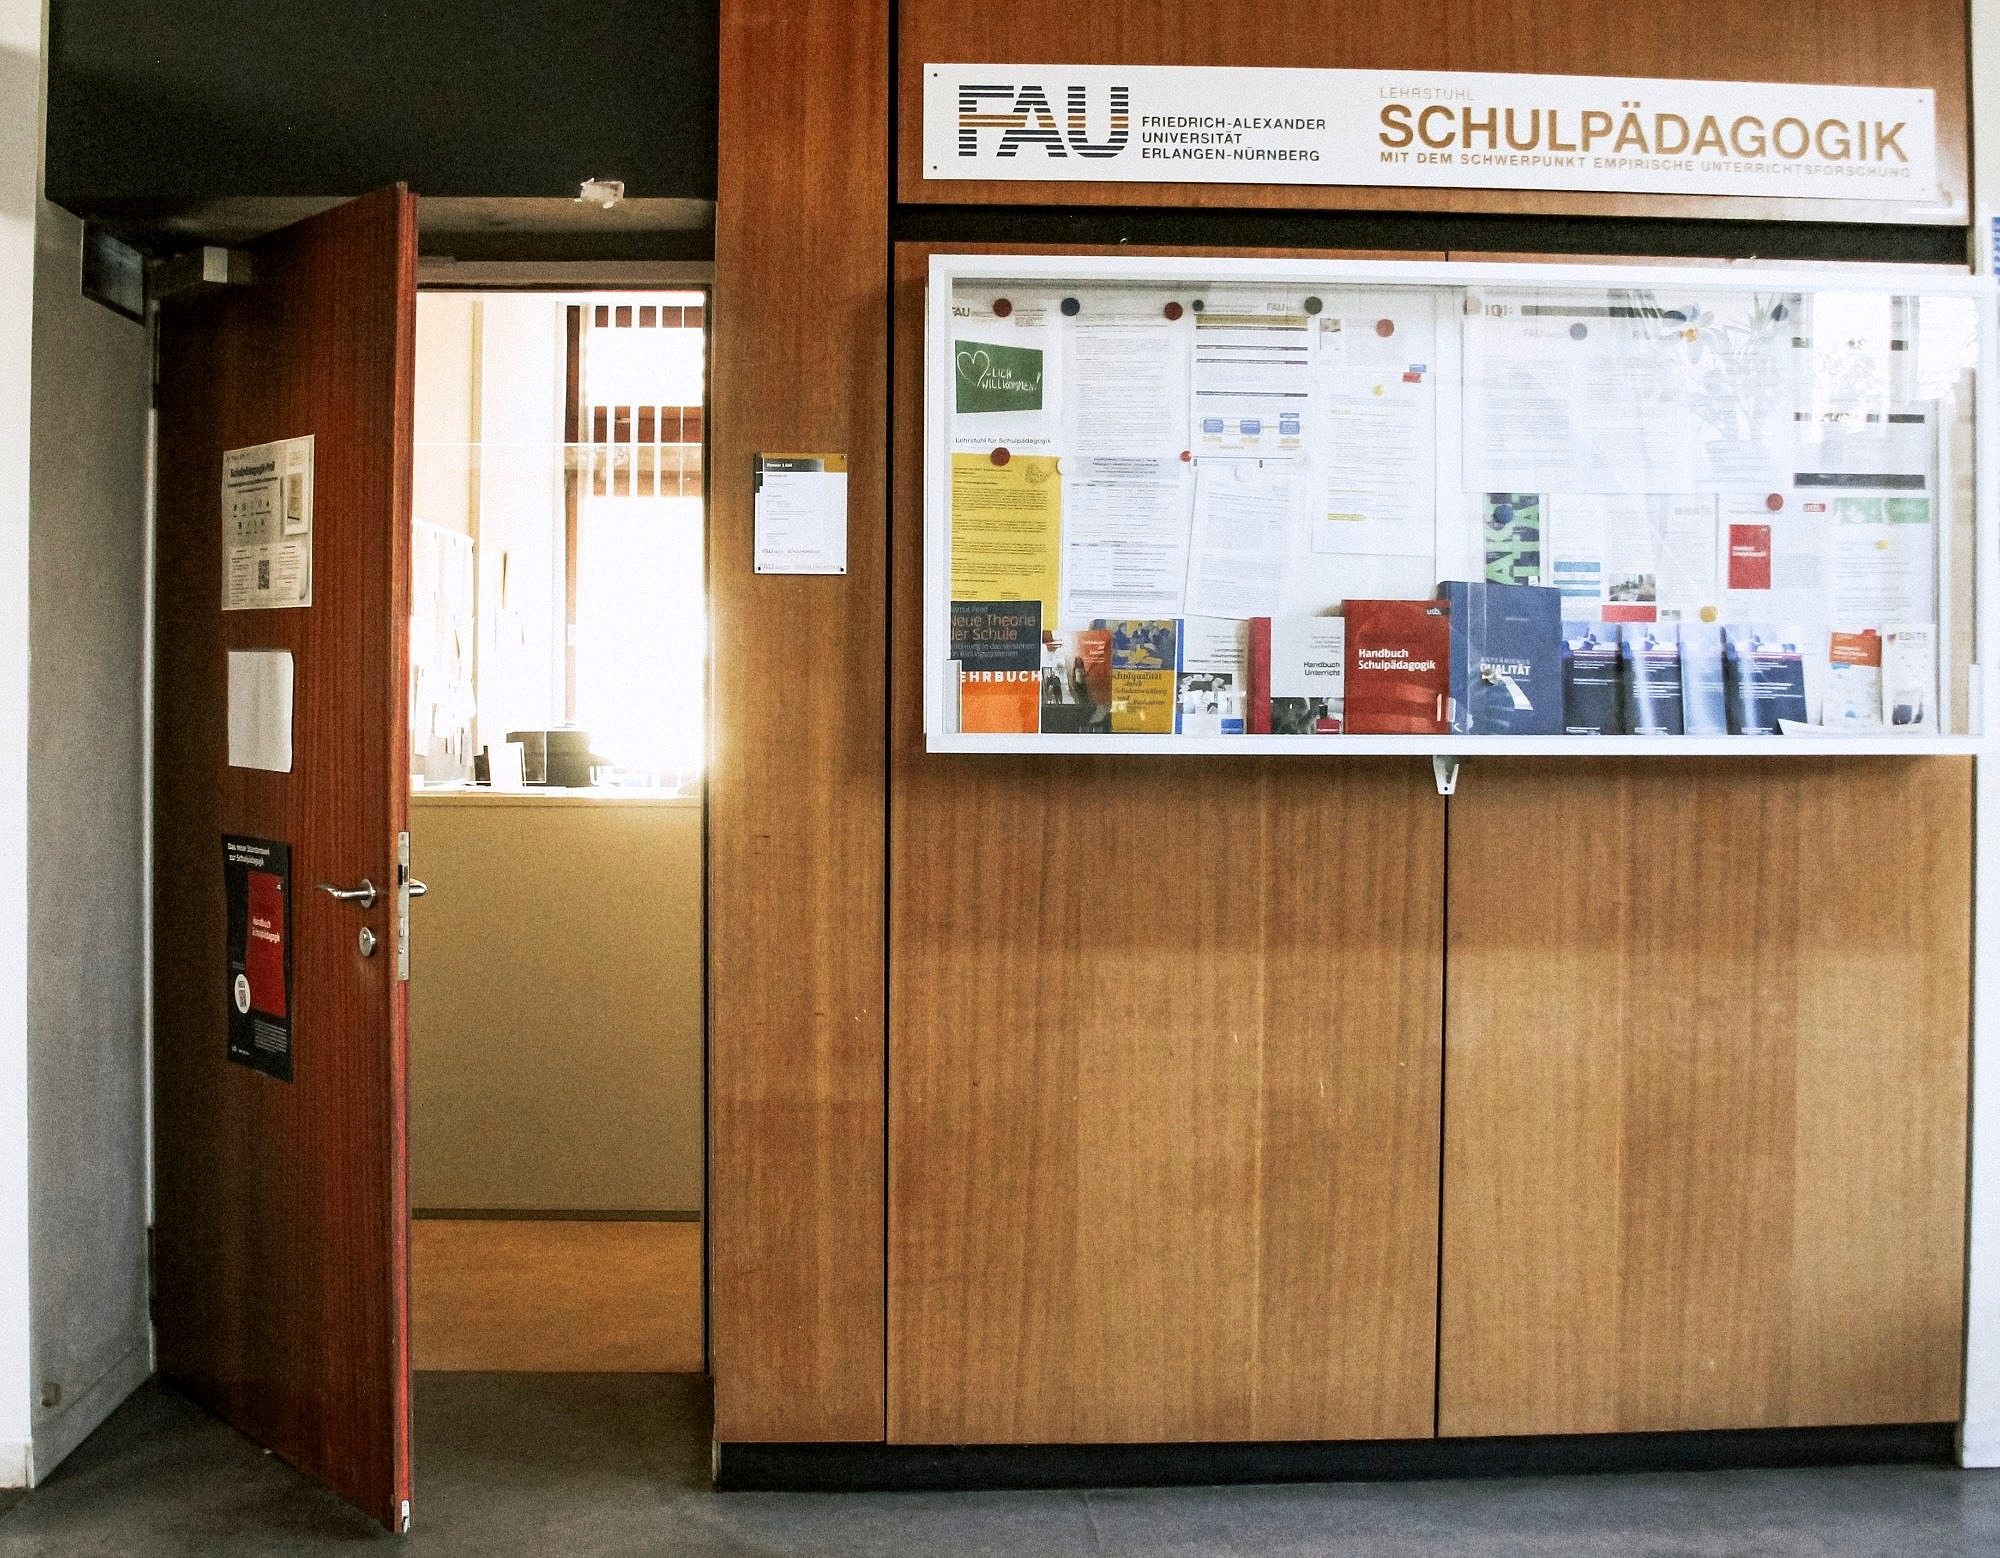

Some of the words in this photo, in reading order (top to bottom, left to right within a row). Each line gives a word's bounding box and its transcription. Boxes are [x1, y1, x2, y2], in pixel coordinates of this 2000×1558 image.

[1379, 87, 1475, 101] LEHRSTUHL
[959, 85, 1129, 157] FAU
[1142, 116, 1326, 130] FRIEDRICH-ALEXANDER
[1142, 131, 1242, 144] UNIVERSITÄT
[1379, 101, 1908, 163] SCHULPÄDAGOGIK
[1142, 146, 1320, 162] ERLANGEN-NÜRNBERG
[1380, 152, 1409, 163] MIT
[1417, 152, 1452, 164] DEM
[1460, 154, 1586, 169] SCHWERPUNKT
[1593, 157, 1694, 172] EMPIRISCHE
[1701, 162, 1911, 178] UNTERRICHTSFORSCHUNG
[987, 612, 1036, 627] Theorie
[972, 626, 1018, 641] Schule
[1358, 648, 1409, 658] Handbuch
[1303, 660, 1341, 668] Handbuch
[1358, 660, 1436, 672] Schulpädagogik
[960, 671, 1041, 683] EHRBUCH
[1304, 669, 1341, 677] Unterricht
